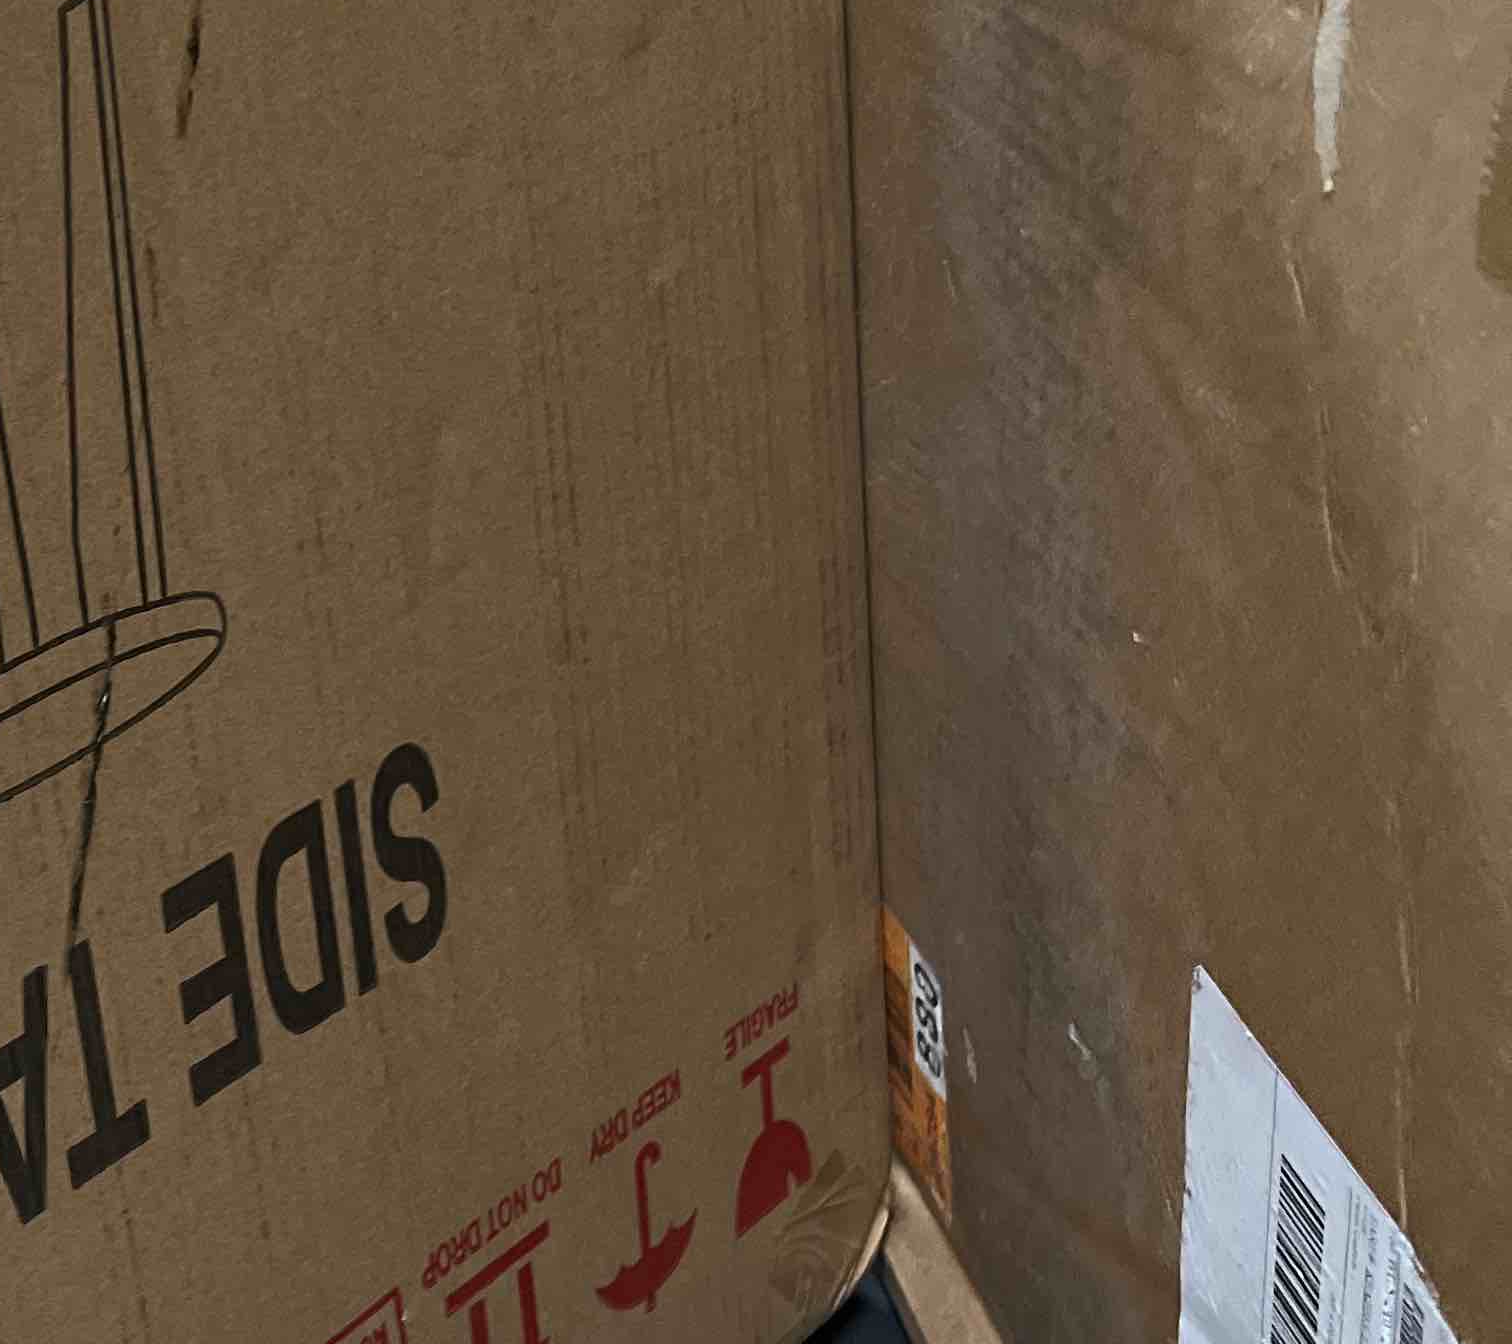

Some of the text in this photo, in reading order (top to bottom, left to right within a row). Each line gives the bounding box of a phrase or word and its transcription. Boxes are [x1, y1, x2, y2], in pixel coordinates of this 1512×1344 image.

[162, 742, 448, 1107] SIDE
[724, 982, 799, 1061] FRAGILE
[590, 1068, 682, 1163] KEEP DRY
[421, 1157, 564, 1290] DO NOT DROP
